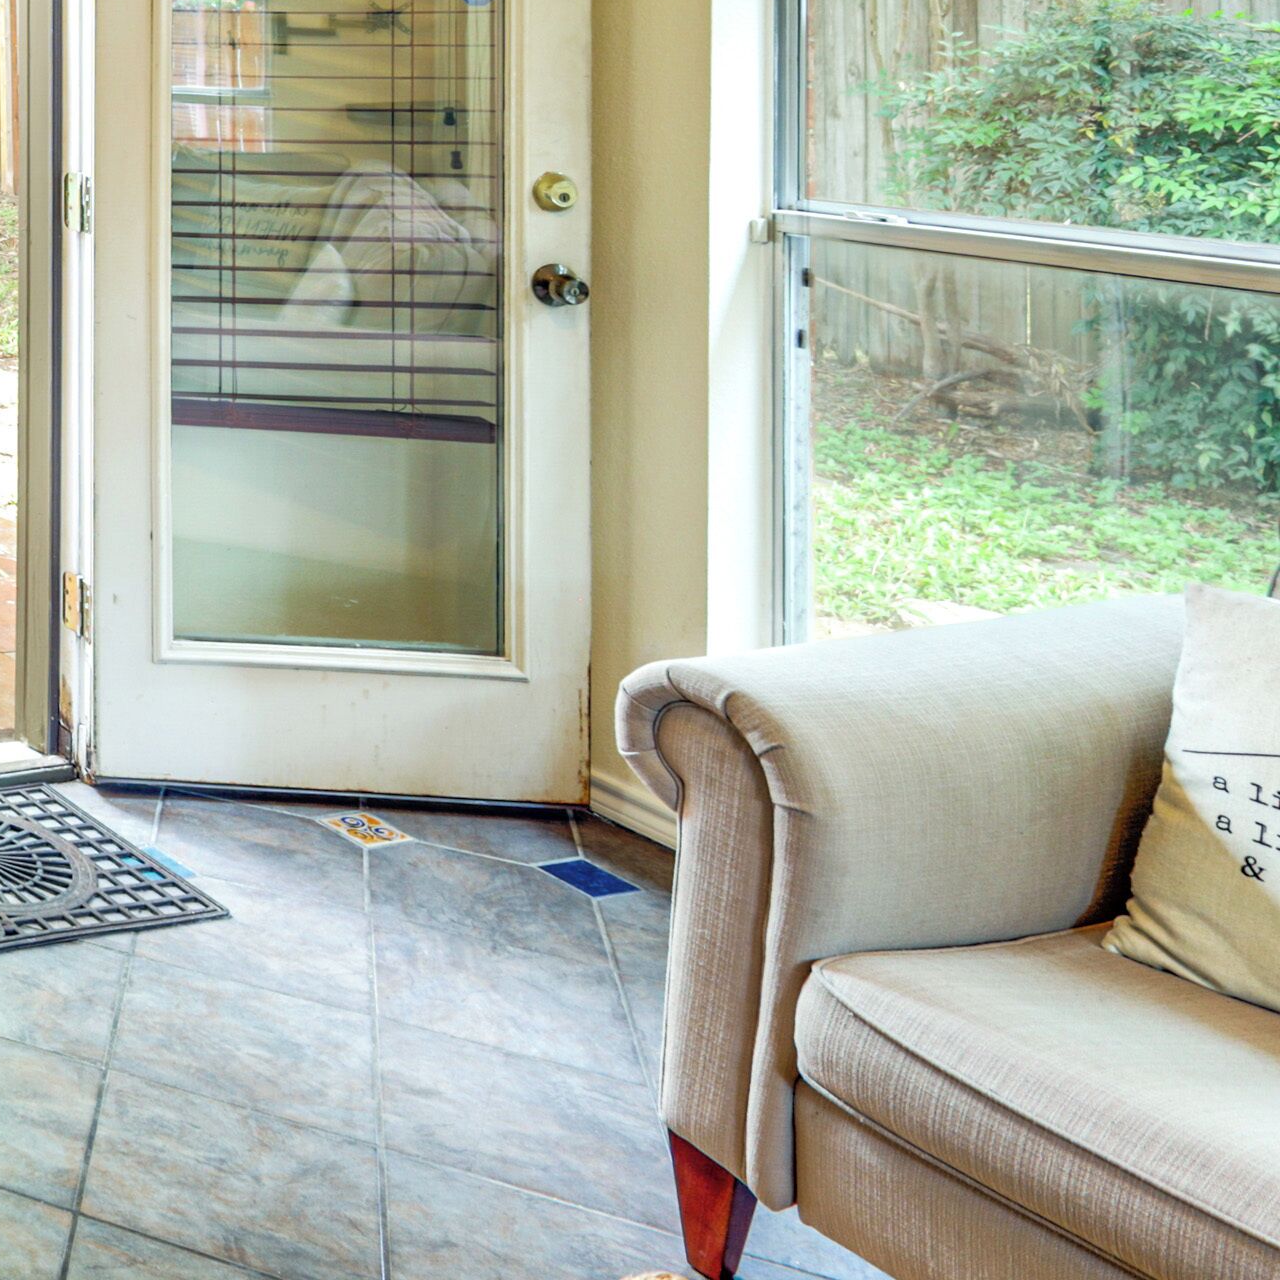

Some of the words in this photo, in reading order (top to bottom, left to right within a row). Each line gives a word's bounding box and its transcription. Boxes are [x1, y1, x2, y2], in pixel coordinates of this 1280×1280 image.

[1212, 775, 1230, 794] a
[1215, 814, 1233, 834] a
[1240, 855, 1266, 882] &
